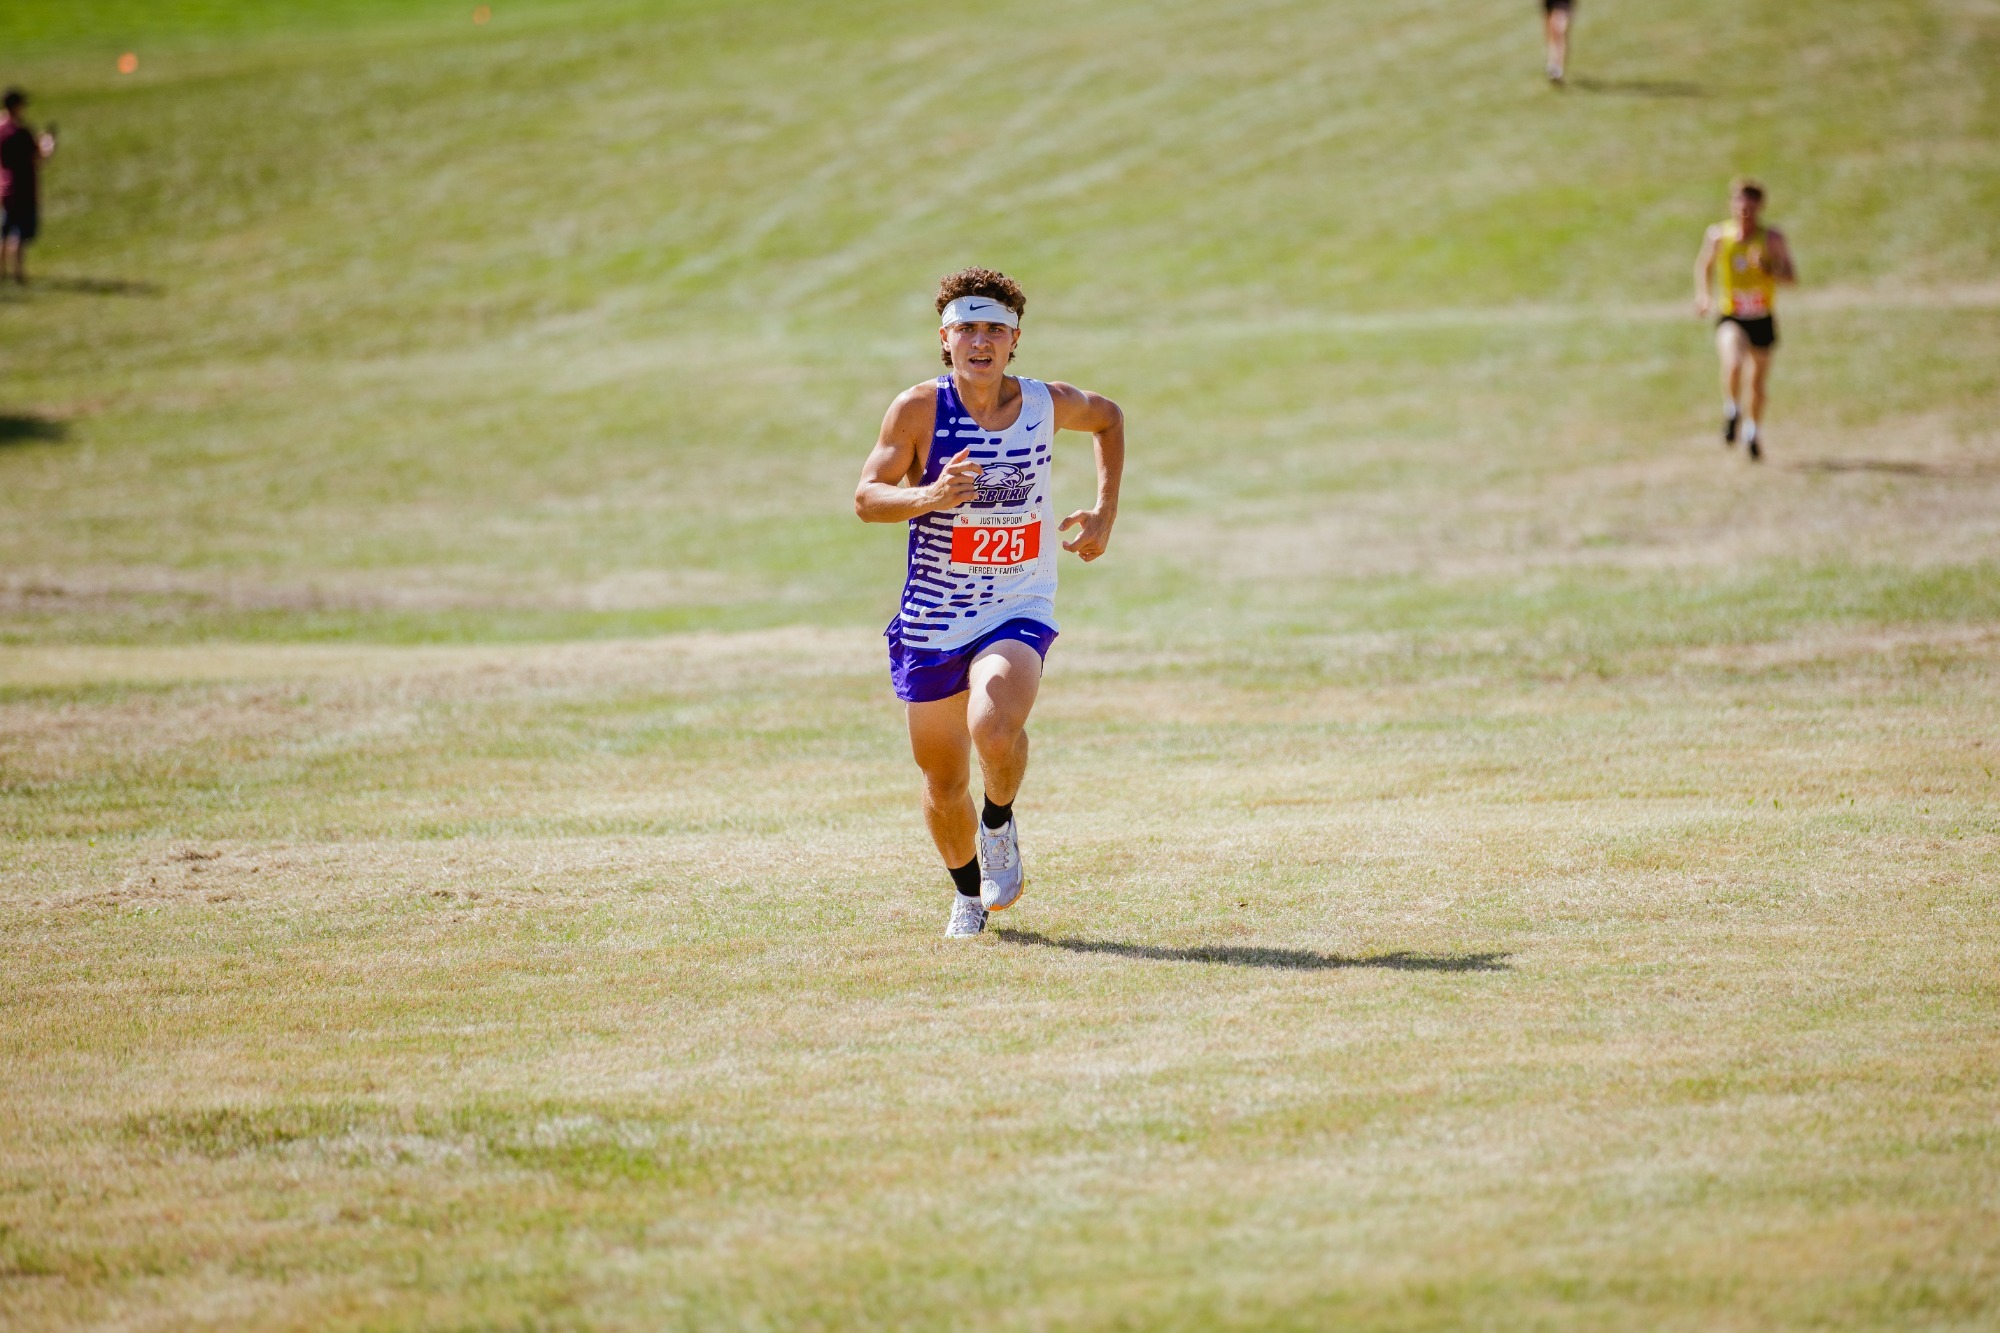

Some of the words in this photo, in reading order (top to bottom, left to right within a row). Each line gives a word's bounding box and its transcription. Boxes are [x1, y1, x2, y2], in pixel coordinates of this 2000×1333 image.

[969, 486, 1030, 503] SBURY
[979, 516, 1001, 525] JUSTIN
[972, 528, 1026, 562] 225
[968, 565, 998, 575] FIERCELY
